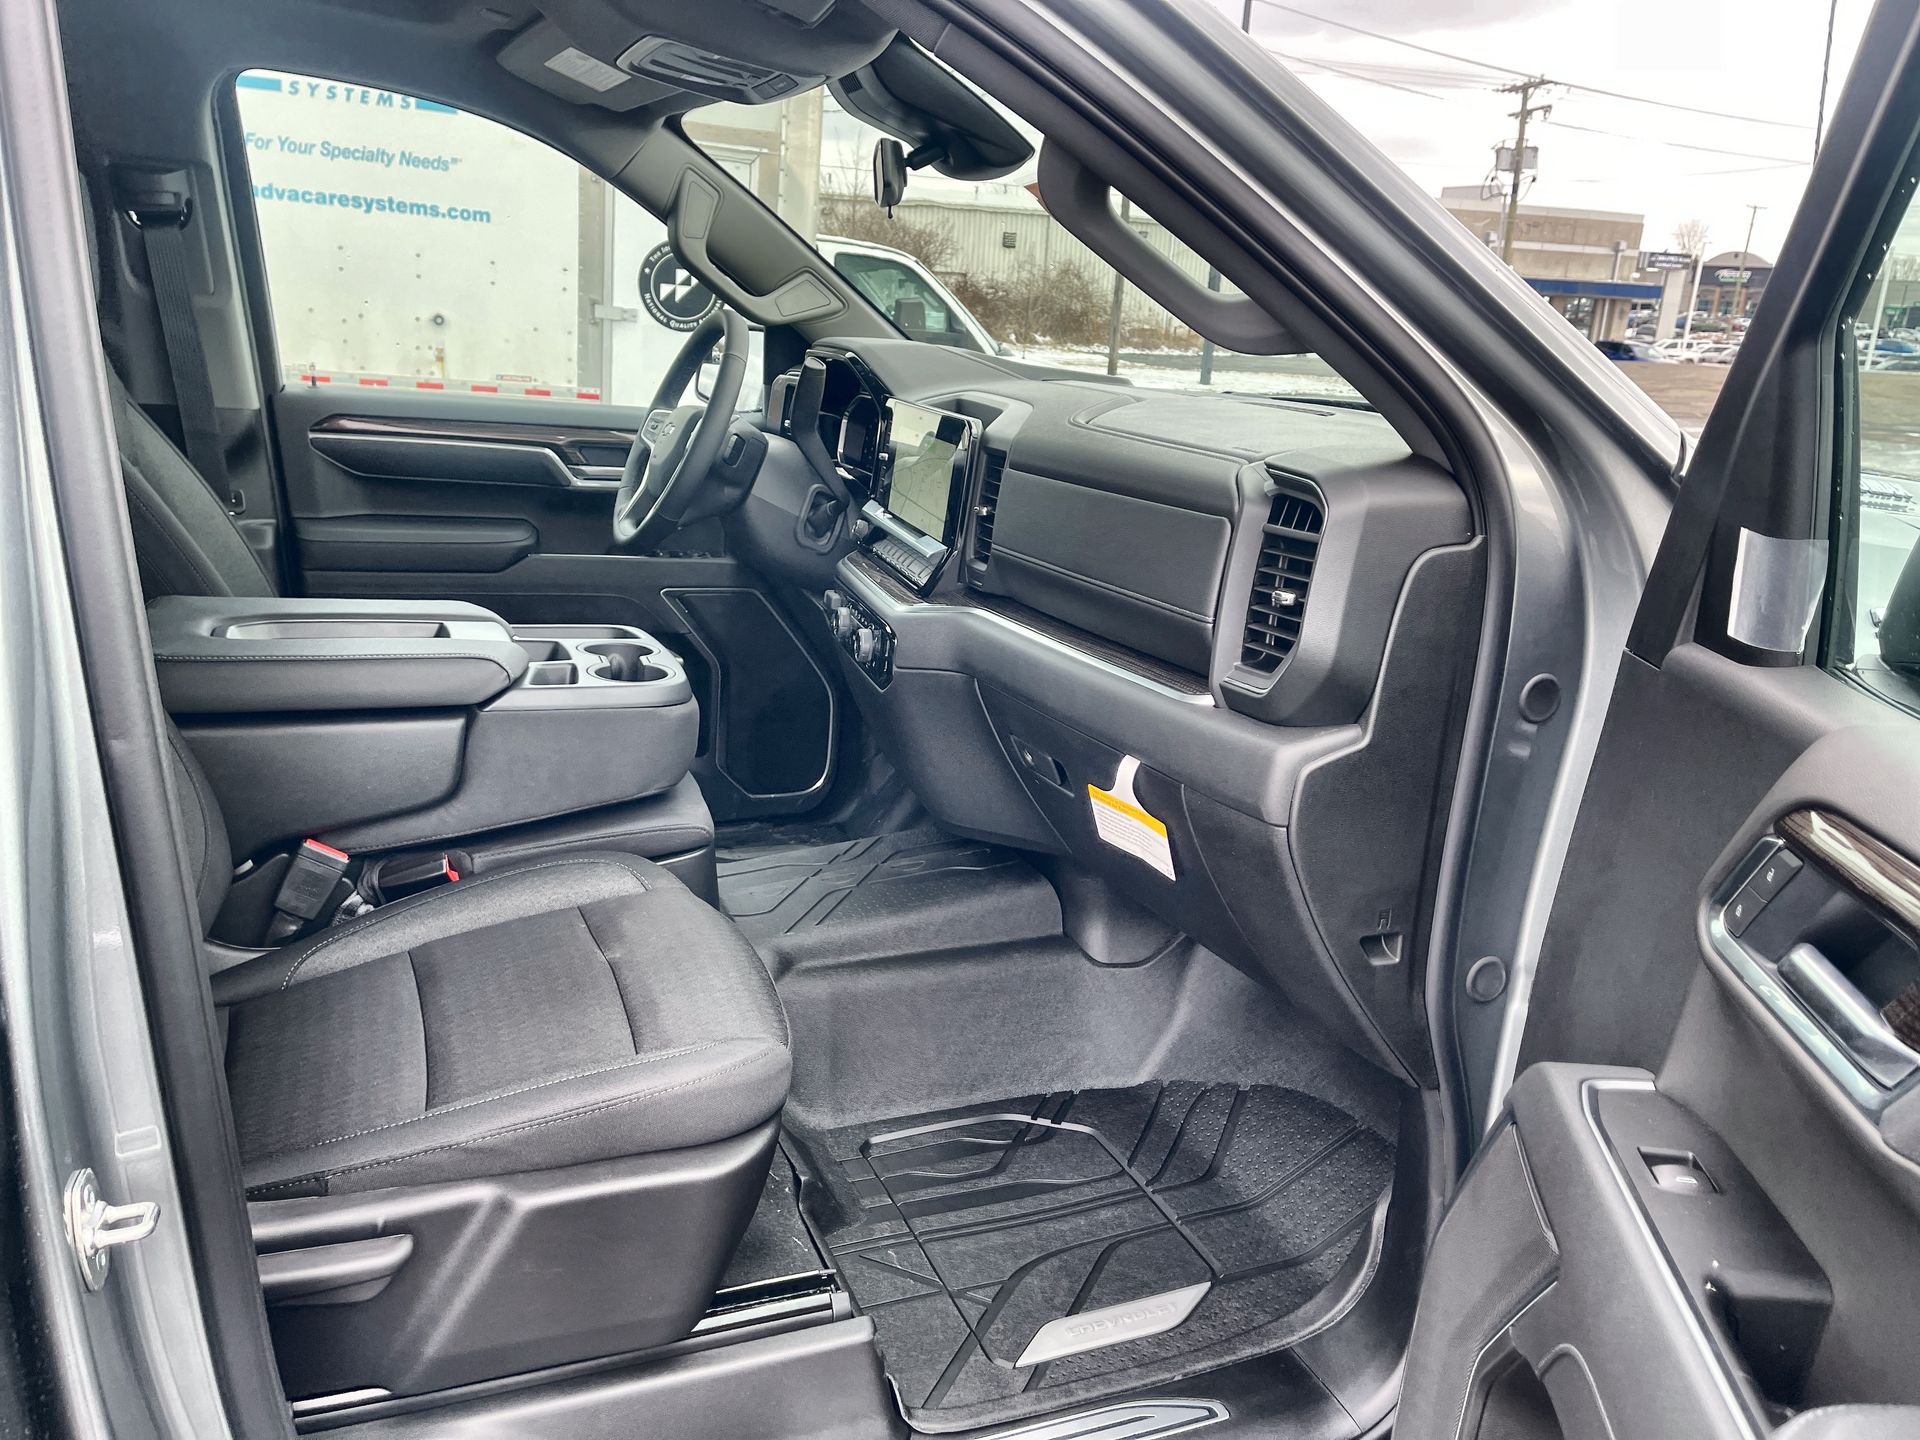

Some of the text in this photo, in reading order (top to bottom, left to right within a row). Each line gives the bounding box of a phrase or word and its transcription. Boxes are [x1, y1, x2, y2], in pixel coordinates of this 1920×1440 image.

[287, 80, 412, 110] SYSTEMS
[245, 132, 272, 150] For
[277, 135, 316, 155] Your
[320, 141, 395, 168] Specialty
[644, 293, 668, 323] NATIONAL
[669, 319, 698, 329] QUALITY
[1065, 1303, 1177, 1336] CHEVROLET
